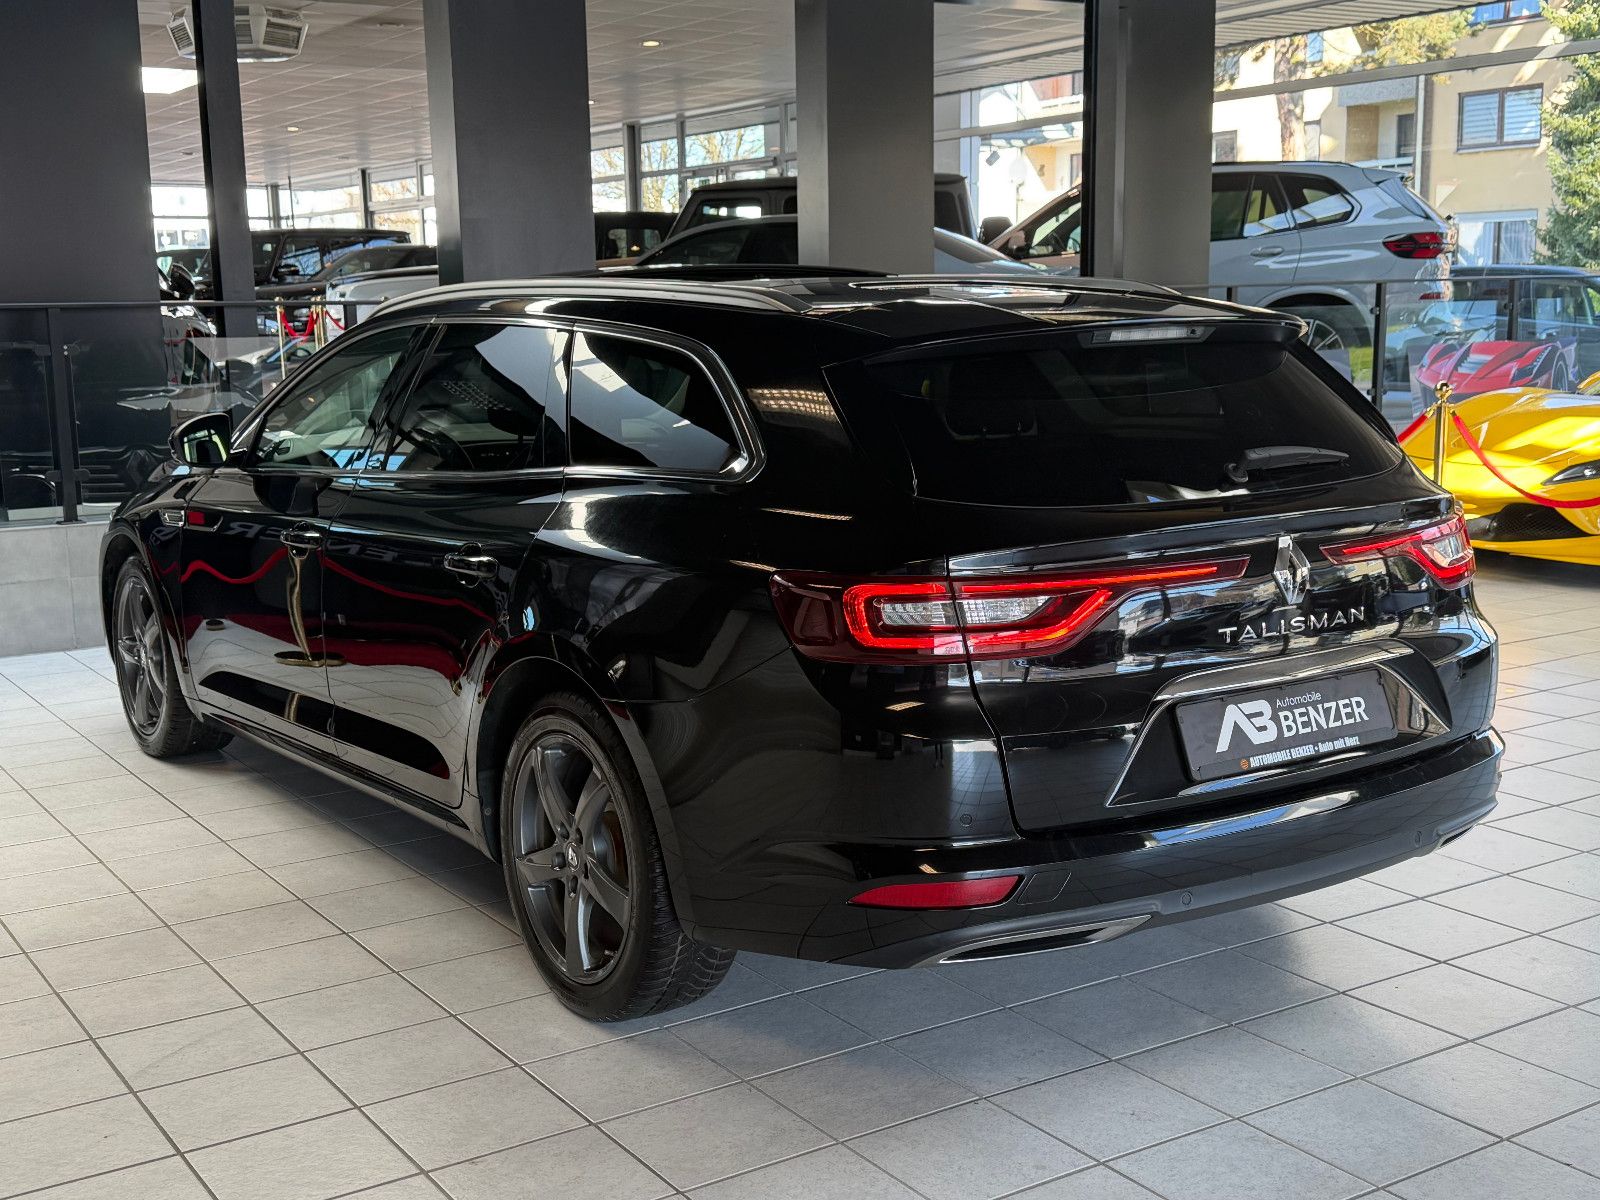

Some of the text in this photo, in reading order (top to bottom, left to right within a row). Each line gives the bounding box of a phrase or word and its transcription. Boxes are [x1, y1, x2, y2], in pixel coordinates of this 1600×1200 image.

[1218, 606, 1365, 644] TALISMAN
[1276, 691, 1322, 708] Automobile
[1278, 696, 1369, 738] BENZER
[1250, 736, 1361, 768] AUTOMOBILE BENZER Auto mit Herz
